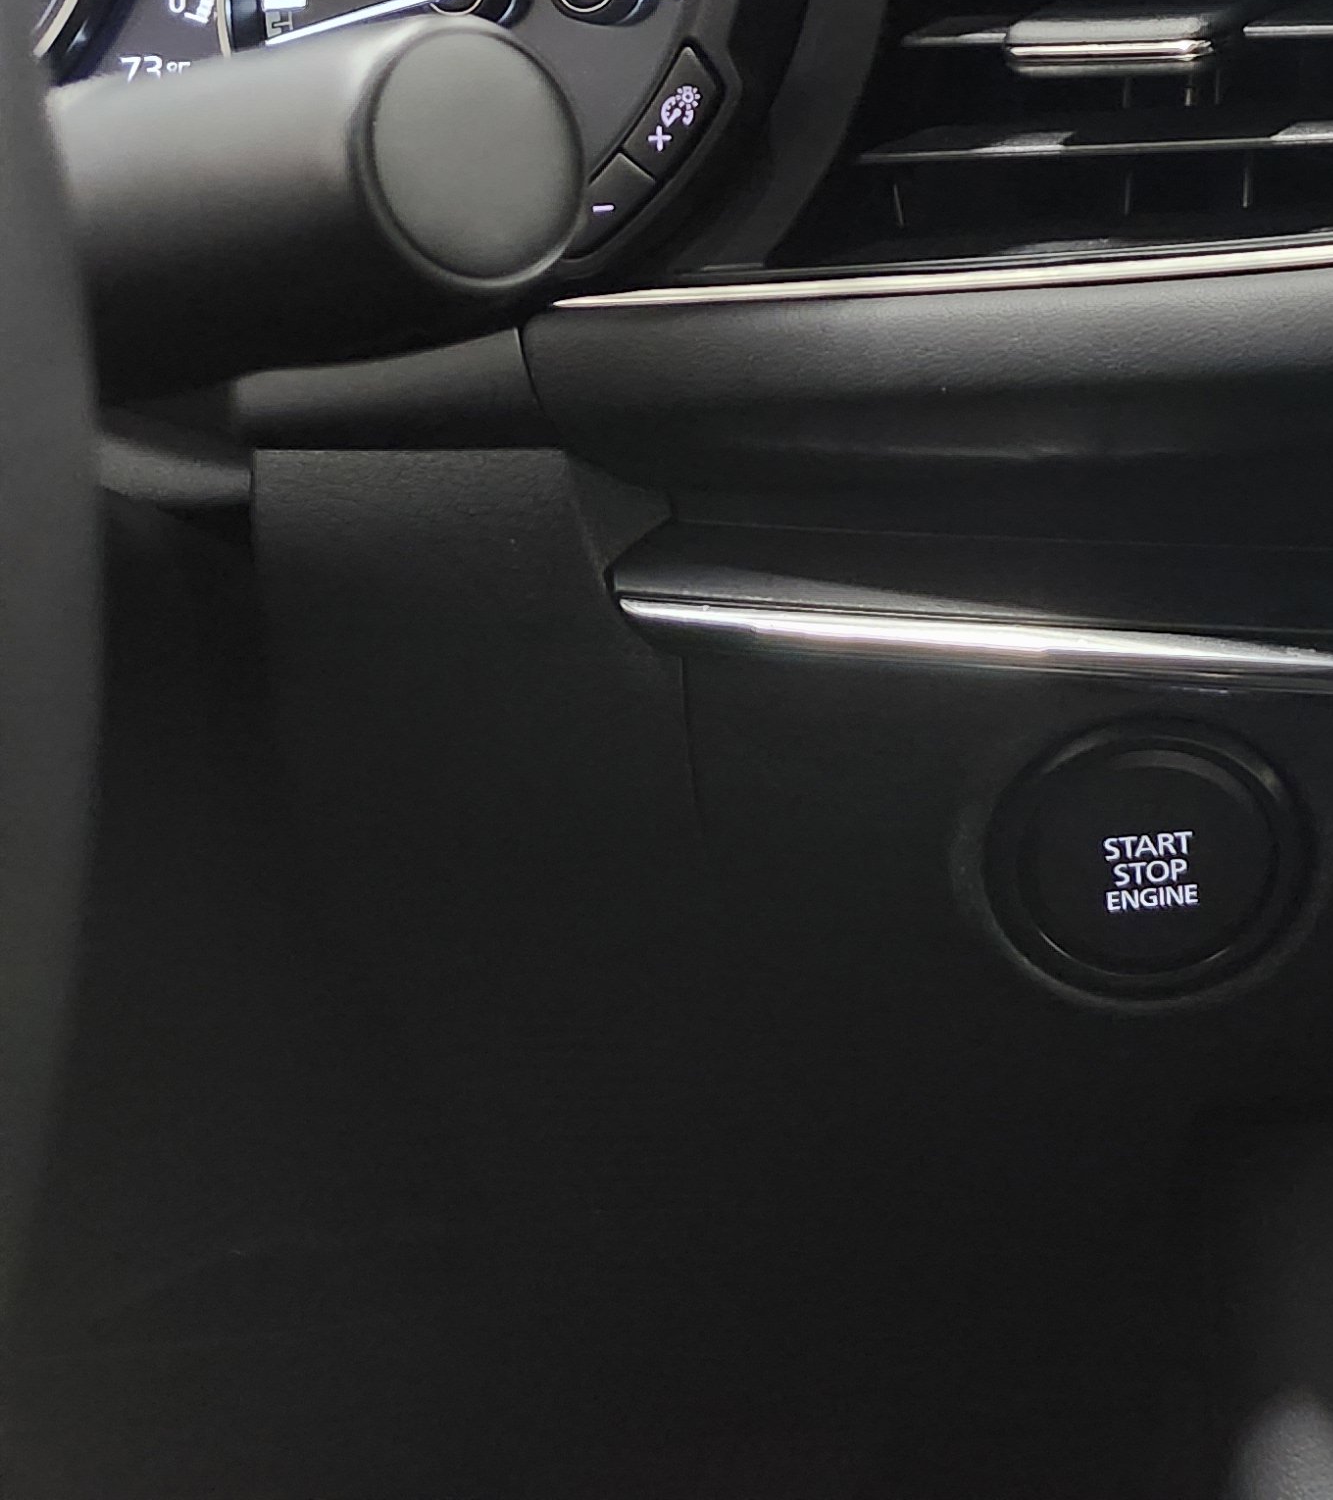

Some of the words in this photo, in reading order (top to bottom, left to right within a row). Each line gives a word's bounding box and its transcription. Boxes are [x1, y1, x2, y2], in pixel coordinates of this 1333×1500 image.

[1103, 831, 1193, 862] START
[1113, 859, 1190, 886] STOP
[1105, 883, 1199, 913] ENGINE
